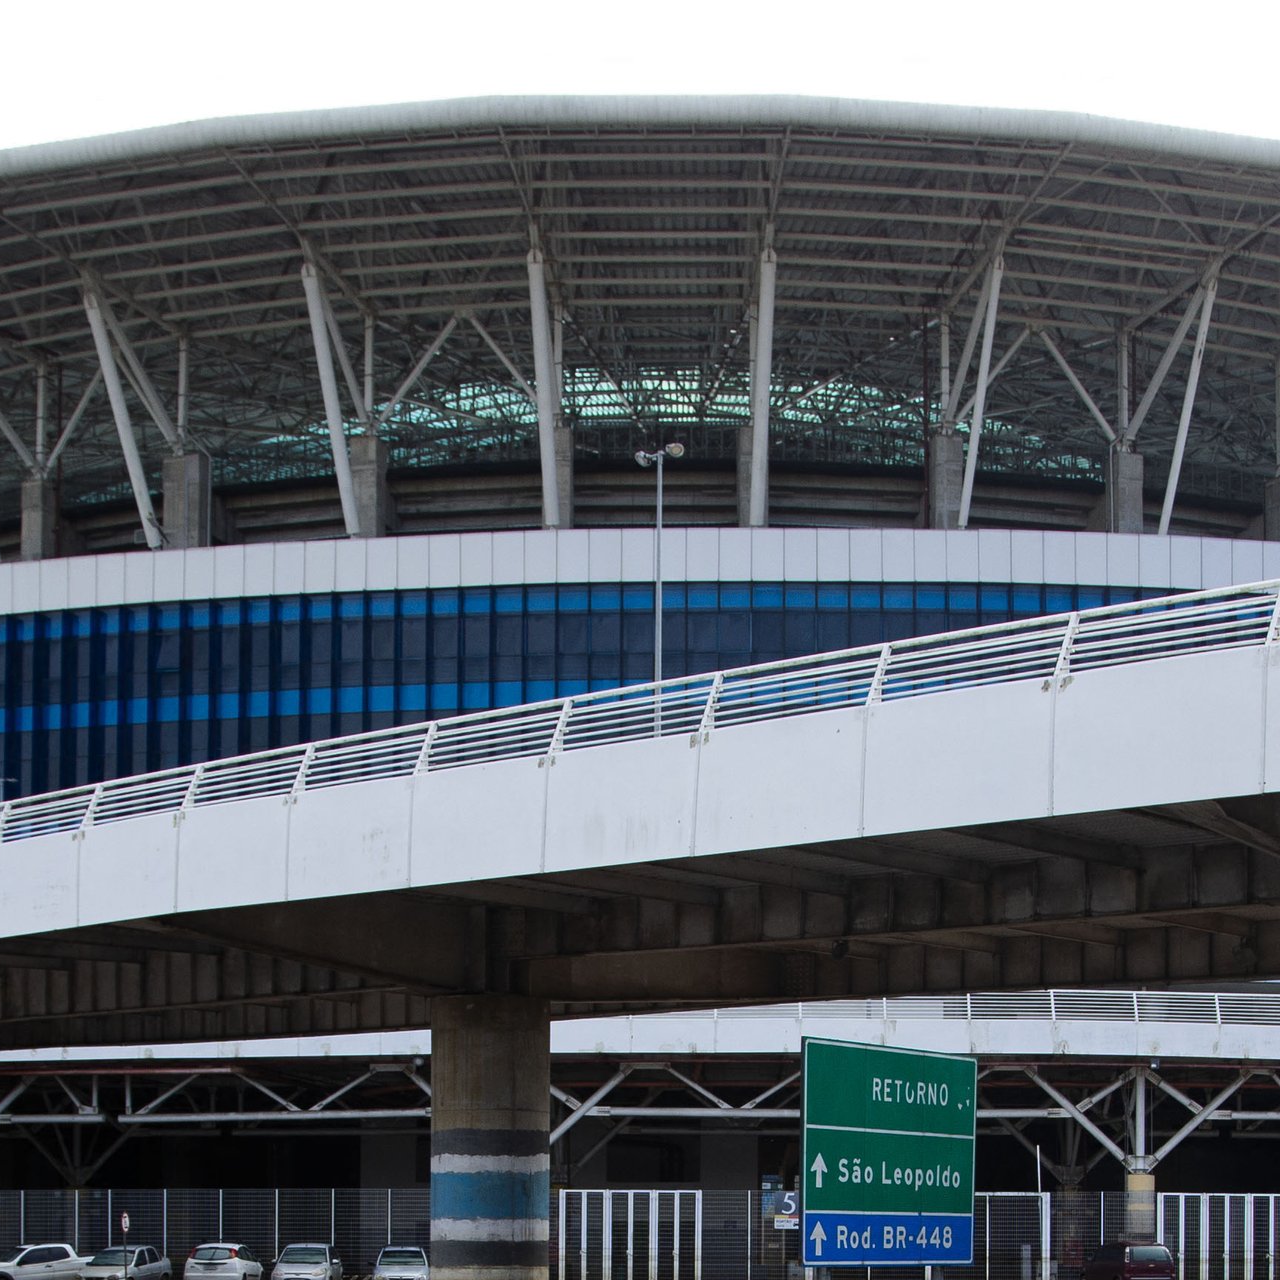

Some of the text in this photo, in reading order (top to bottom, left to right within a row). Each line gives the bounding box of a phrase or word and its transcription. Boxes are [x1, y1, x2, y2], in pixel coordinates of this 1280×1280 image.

[872, 1077, 949, 1106] RETORNO
[838, 1158, 961, 1191] São Leopoldo
[781, 1192, 797, 1215] 5
[837, 1225, 953, 1249] Rod. BR-448
